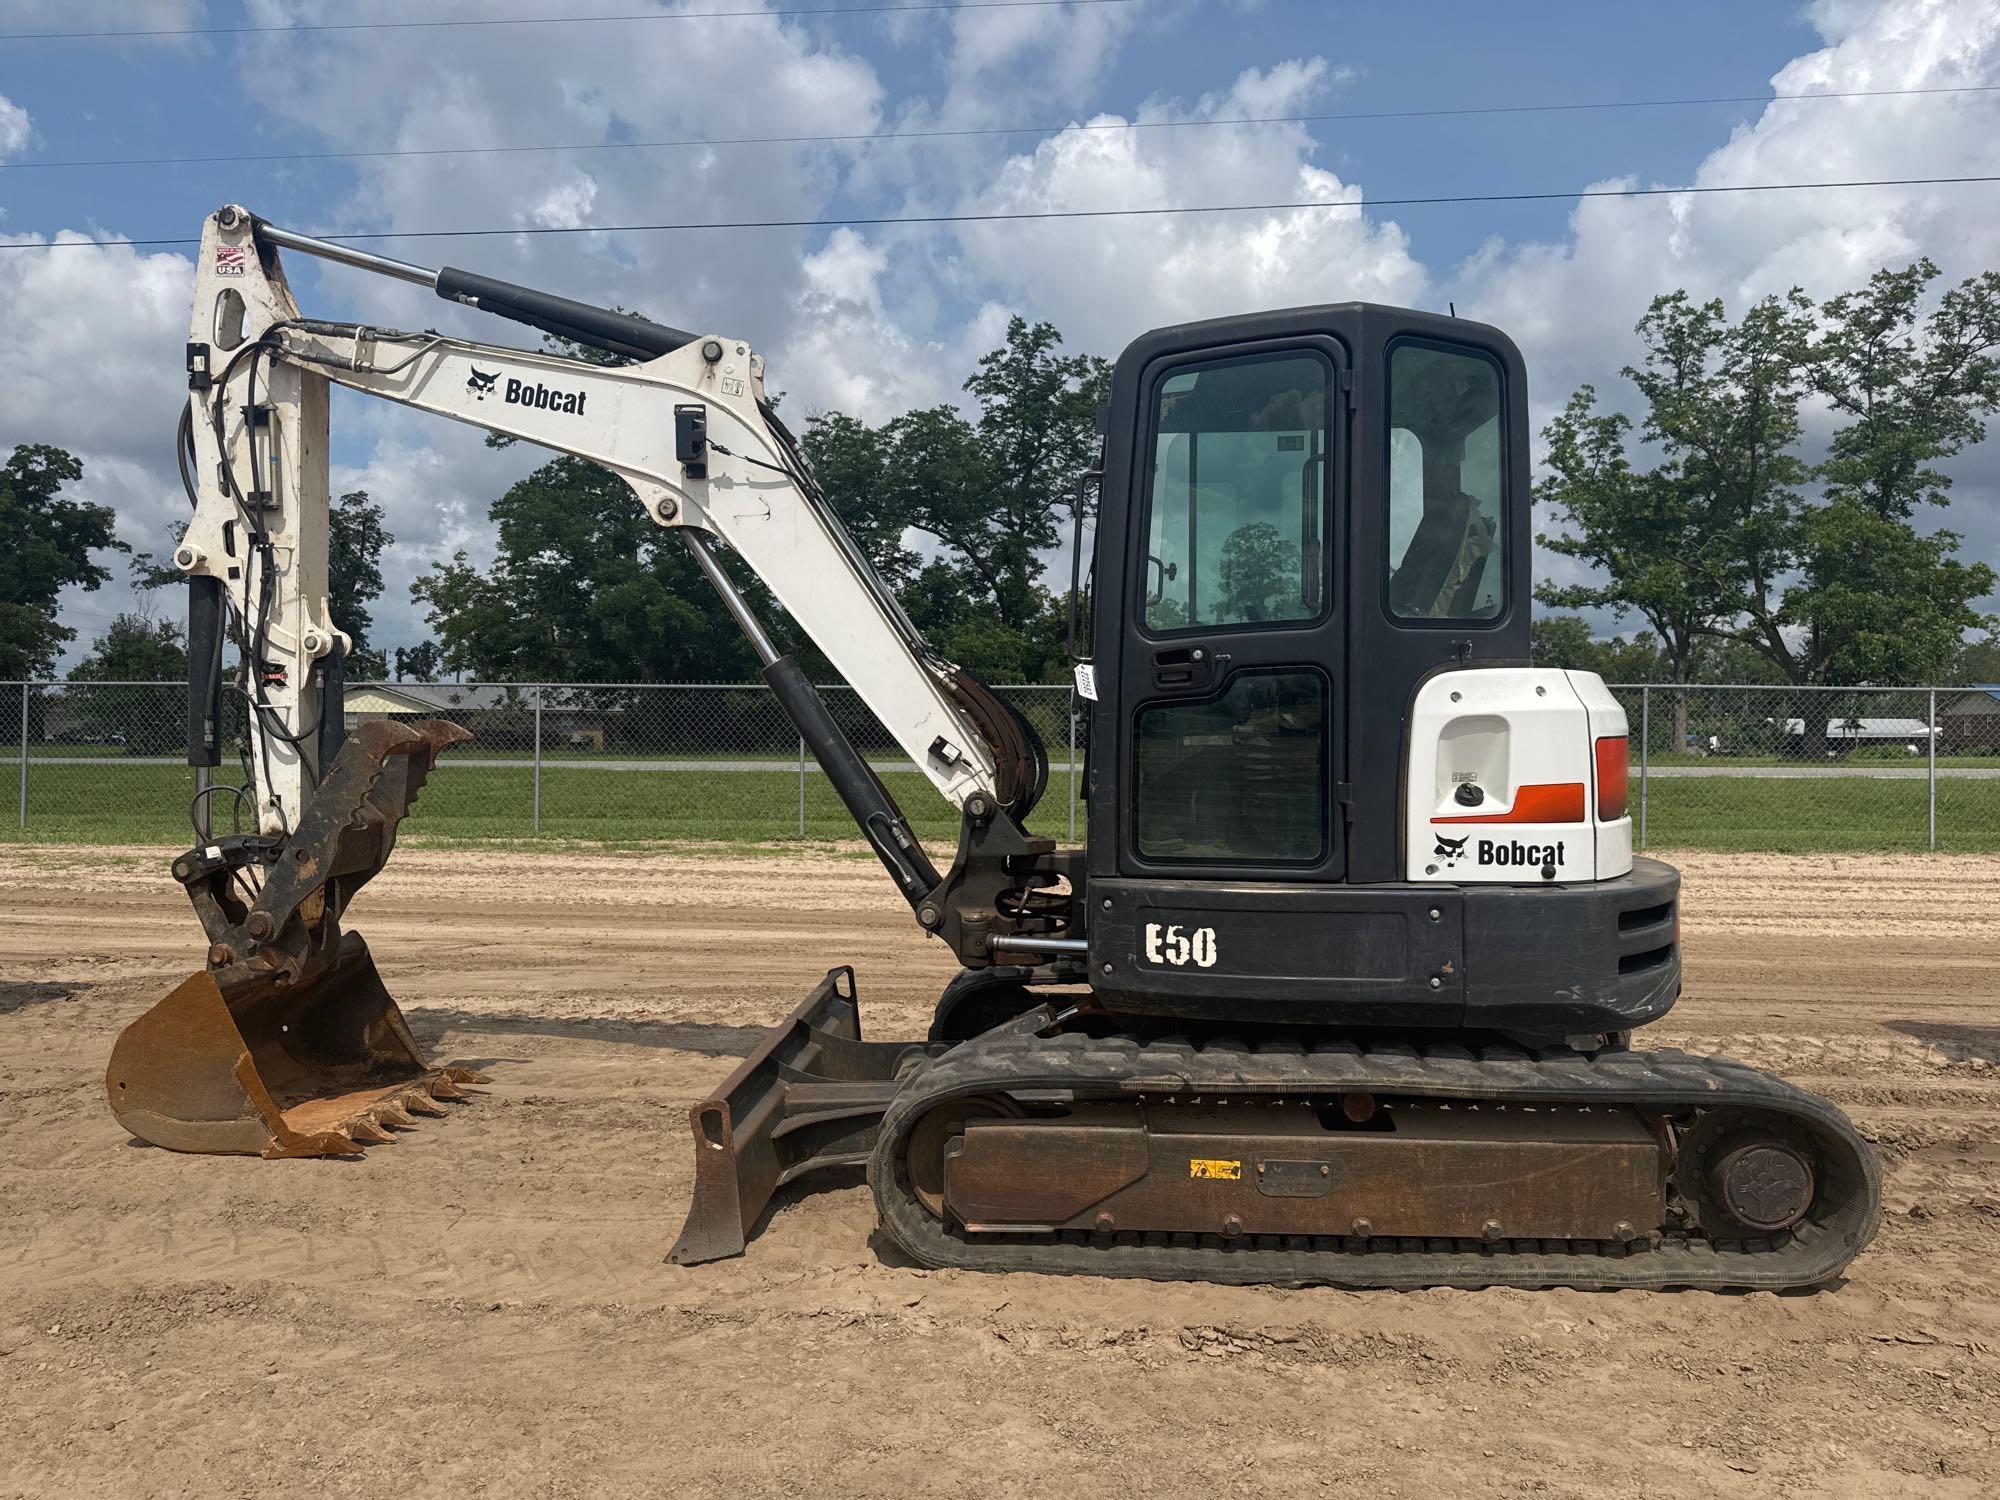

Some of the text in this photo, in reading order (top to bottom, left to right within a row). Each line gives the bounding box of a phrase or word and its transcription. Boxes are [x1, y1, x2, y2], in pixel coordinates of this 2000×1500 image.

[218, 266, 242, 274] USA
[505, 378, 587, 416] Bobcat
[1478, 839, 1565, 866] Bobcat
[1145, 922, 1218, 968] E50
